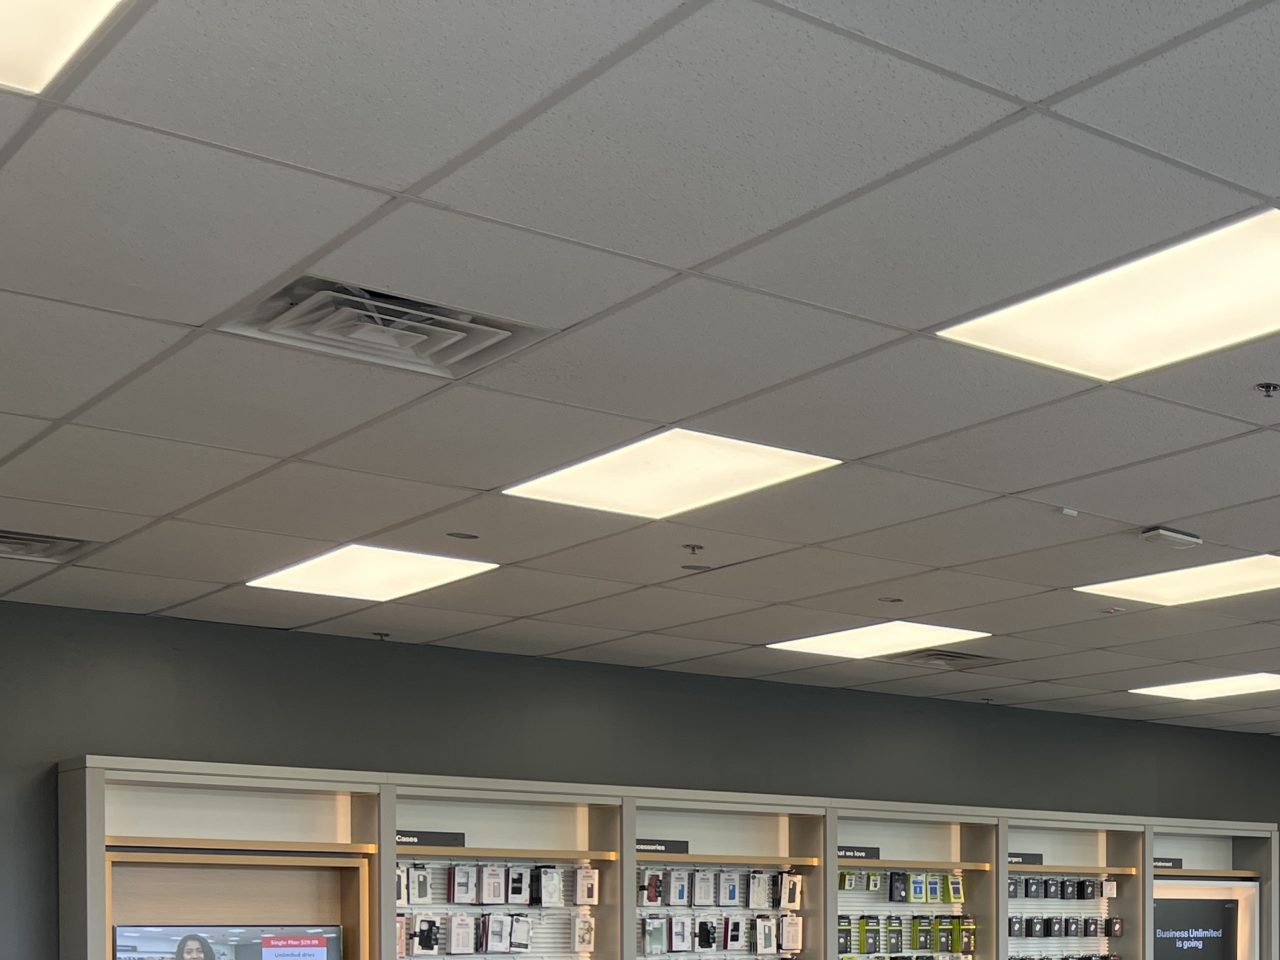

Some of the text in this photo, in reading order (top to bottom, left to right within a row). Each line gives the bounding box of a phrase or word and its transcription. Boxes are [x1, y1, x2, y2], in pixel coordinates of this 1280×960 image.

[1156, 928, 1222, 938] Business Unlimited
[1176, 939, 1203, 950] is going
